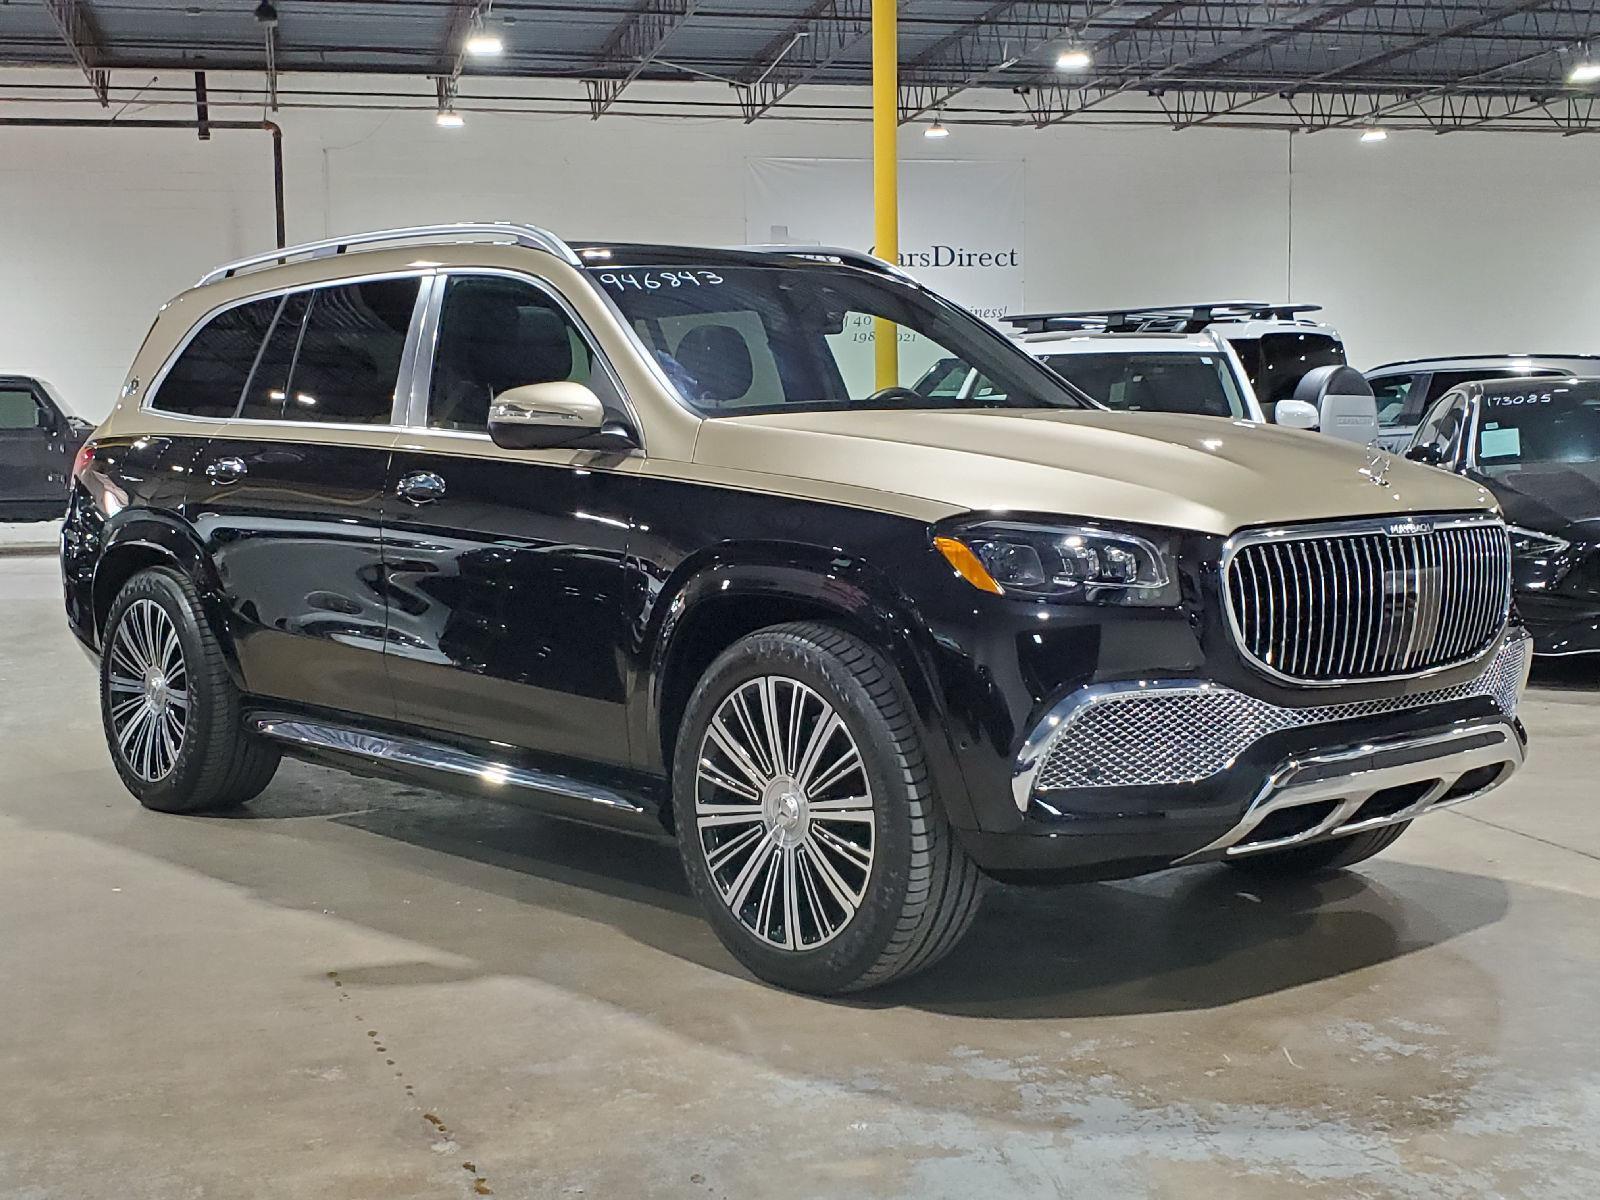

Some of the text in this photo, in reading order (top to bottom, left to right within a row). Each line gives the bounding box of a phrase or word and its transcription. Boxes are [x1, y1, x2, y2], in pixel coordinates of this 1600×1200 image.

[868, 245, 1018, 268] arsDirect
[600, 271, 724, 292] 946843
[1487, 393, 1552, 407] 173085
